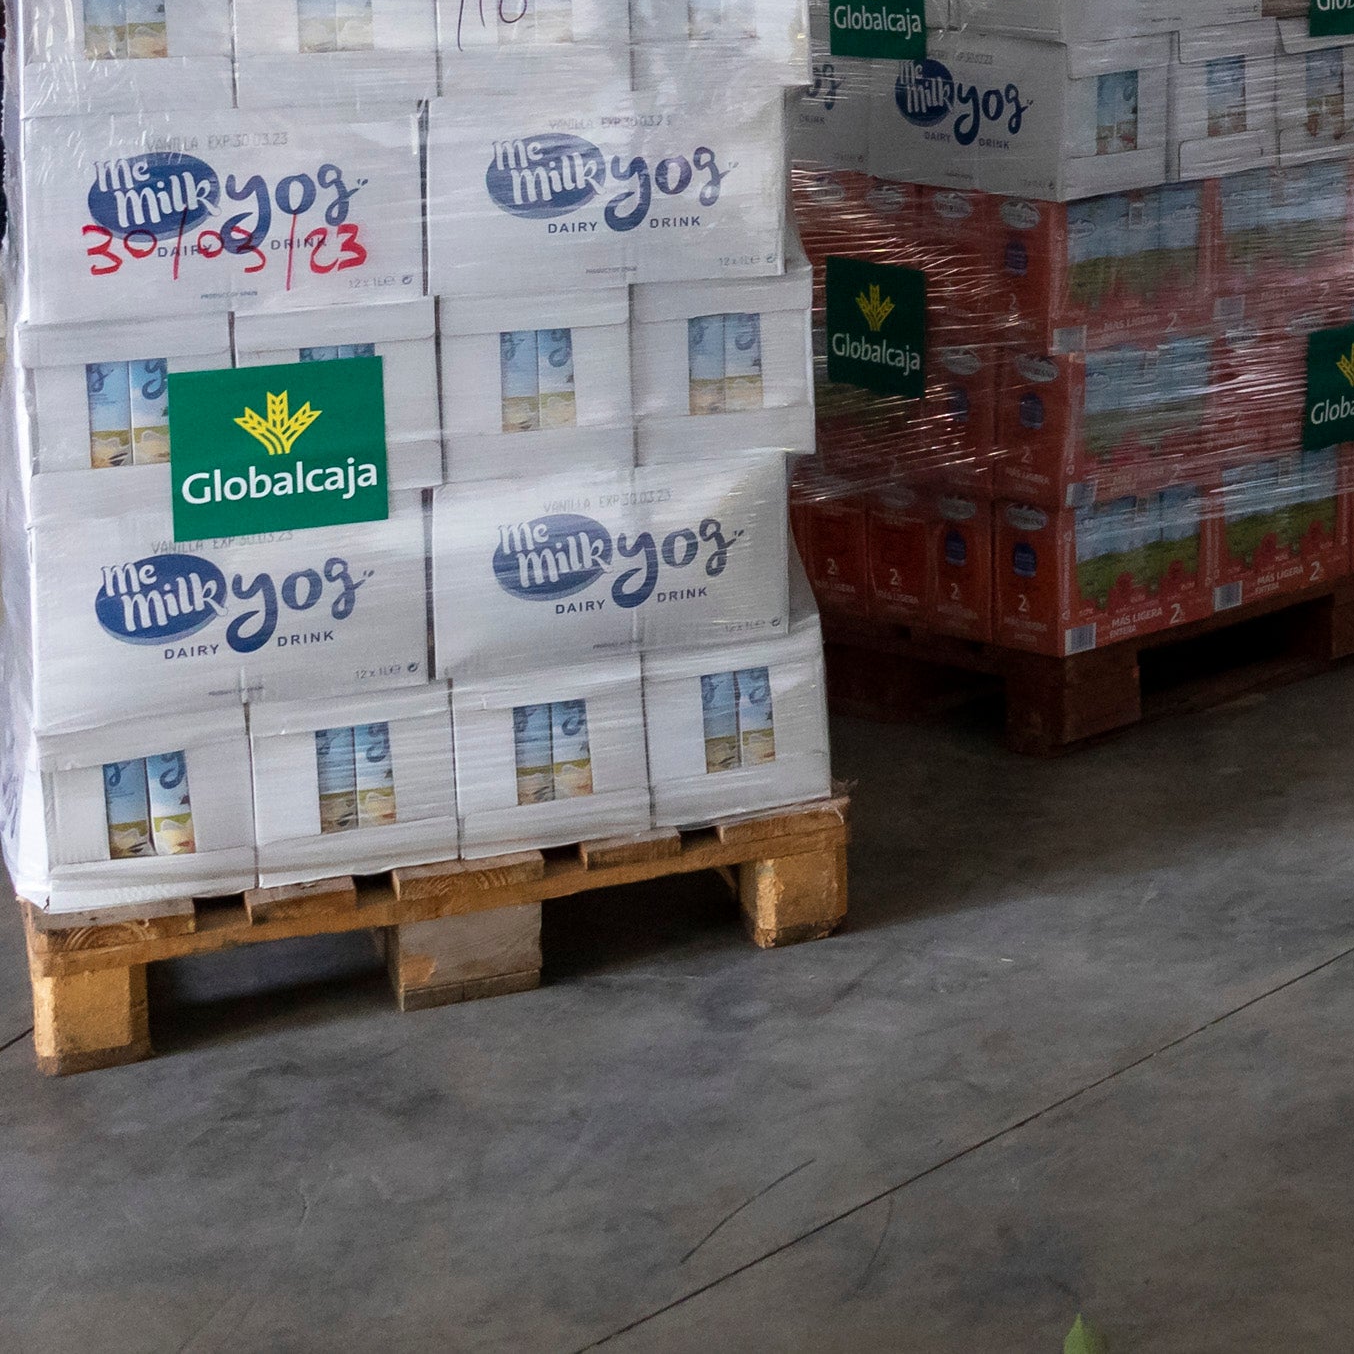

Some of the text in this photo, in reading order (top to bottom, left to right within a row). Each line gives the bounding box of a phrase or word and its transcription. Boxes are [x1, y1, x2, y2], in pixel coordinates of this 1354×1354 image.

[834, 5, 923, 40] Globalcaja
[953, 83, 1029, 146] yog
[220, 163, 364, 254] yog
[604, 146, 732, 232] yog
[82, 206, 368, 291] 30/03/23
[157, 236, 327, 258] DAIRY DRINK
[548, 216, 701, 234] DAIRY DRINK
[832, 332, 921, 376] Globalcaja
[181, 457, 378, 505] Globalcaja
[611, 518, 738, 608] yog
[226, 557, 367, 653] yog
[555, 586, 708, 615] DAIRY DRINK
[164, 630, 335, 660] DAIRY DRINK
